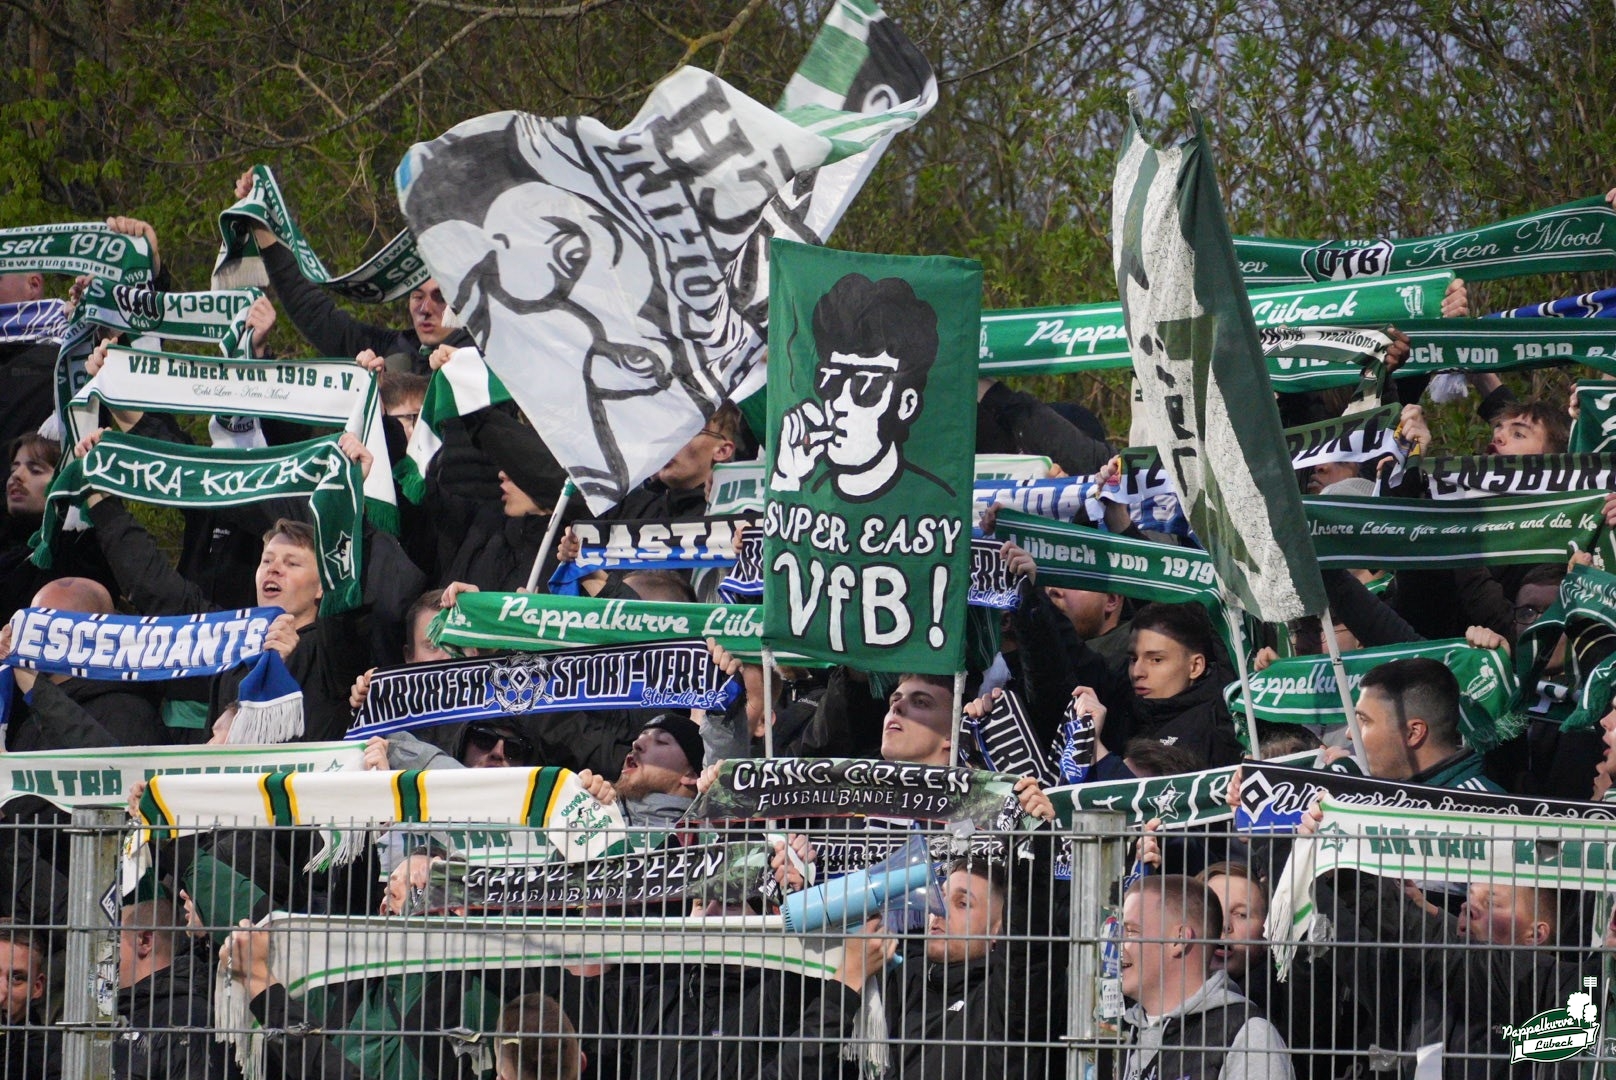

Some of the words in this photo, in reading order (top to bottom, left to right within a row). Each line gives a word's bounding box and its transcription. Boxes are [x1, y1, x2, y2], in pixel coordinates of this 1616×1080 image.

[69, 232, 127, 263] 1919
[1405, 233, 1500, 267] Keen
[1512, 217, 1605, 254] Mood
[1252, 290, 1358, 326] Lübeck
[1455, 347, 1499, 364] von
[128, 355, 160, 375] VfB
[167, 357, 230, 381] Lübeck
[276, 364, 318, 387] 1919
[323, 371, 361, 393] e.V.
[764, 501, 850, 553] SUPER
[859, 517, 962, 554] EASY
[1359, 521, 1406, 535] Leben
[1409, 524, 1438, 542] für
[1519, 513, 1551, 529] und
[1549, 512, 1573, 529] die
[1106, 551, 1149, 573] von
[1160, 554, 1215, 585] 1919
[498, 595, 690, 640] Pappelkurve
[9, 609, 269, 669] DESCENDANTS
[353, 666, 491, 729] AMBURGER
[732, 761, 834, 791] GANG
[843, 763, 970, 794] GREEN
[900, 792, 948, 813] 1919
